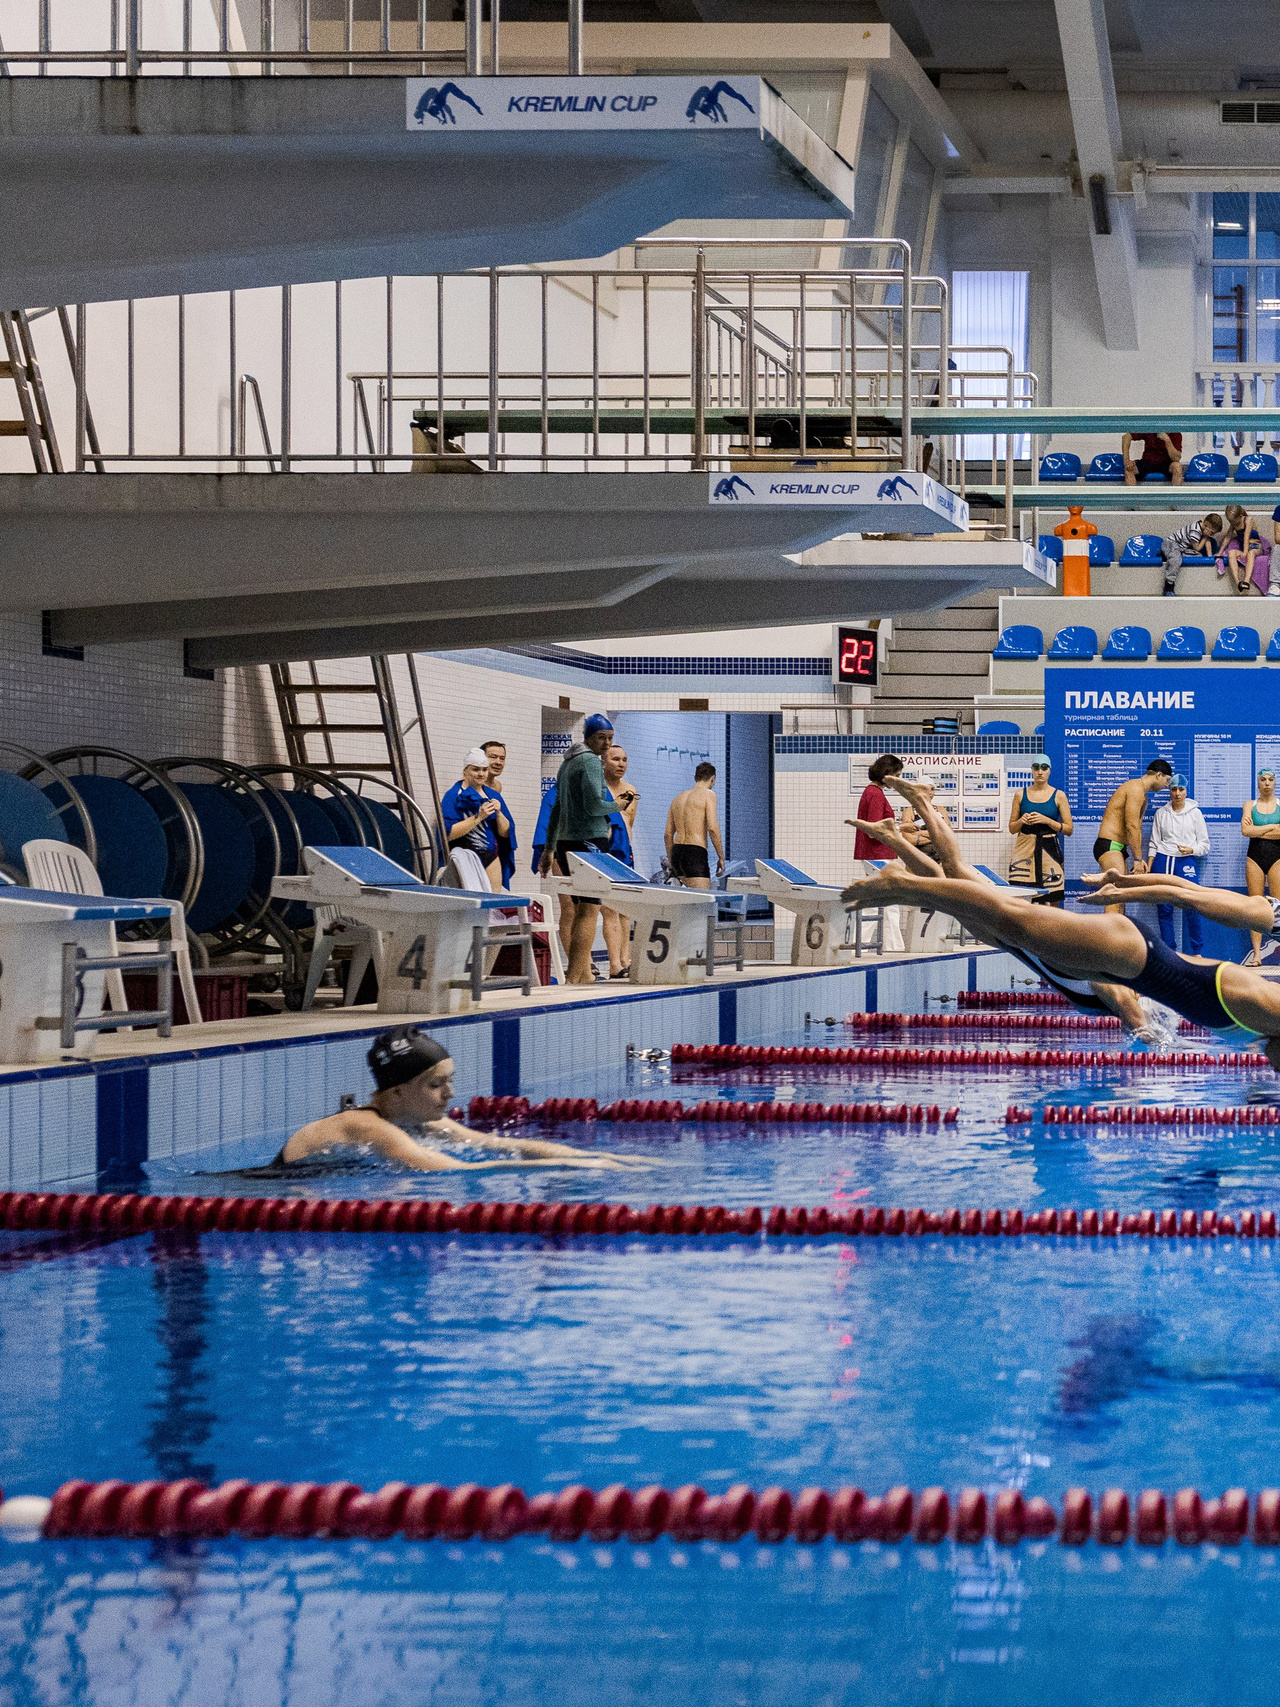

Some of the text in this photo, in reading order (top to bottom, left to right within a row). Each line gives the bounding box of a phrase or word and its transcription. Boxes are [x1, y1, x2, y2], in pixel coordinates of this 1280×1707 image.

[508, 96, 658, 112] KREMLIN CUP
[770, 484, 860, 494] KREMLIN CUP
[841, 638, 874, 674] 22
[1065, 691, 1195, 709] ПЛАВАНИЕ
[902, 756, 982, 765] РАСПИСАНИЕ
[806, 913, 825, 950] 6
[920, 907, 935, 938] 7
[646, 920, 671, 963] 5
[396, 934, 426, 989] 4
